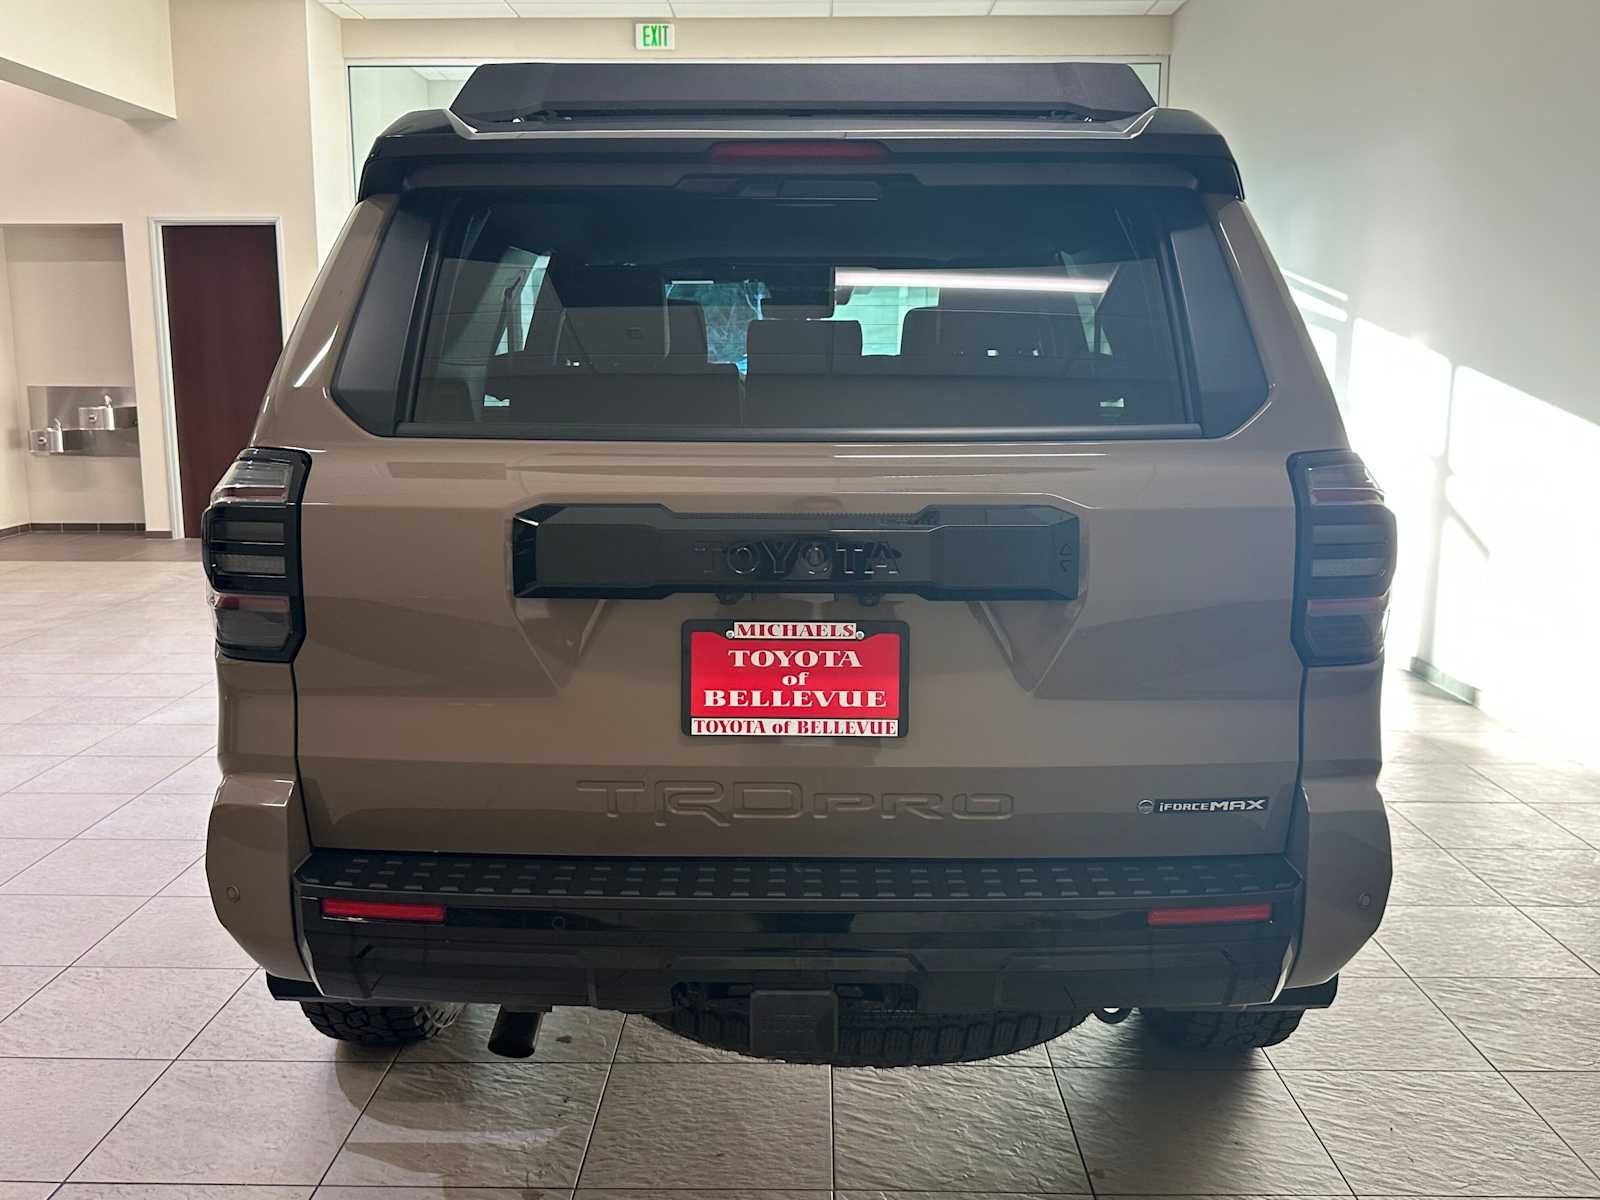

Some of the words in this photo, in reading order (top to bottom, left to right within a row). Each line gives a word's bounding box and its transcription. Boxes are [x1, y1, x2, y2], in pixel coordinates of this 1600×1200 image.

[643, 25, 669, 47] EXIT
[693, 541, 902, 576] TOYOTA
[737, 623, 855, 638] MICHAELS
[728, 650, 863, 668] TOYOTA
[781, 672, 810, 686] of
[703, 690, 887, 708] BELLEVUE
[694, 719, 766, 734] TOYOTA
[772, 719, 792, 734] of
[797, 720, 896, 735] BELLEVUE
[576, 779, 803, 826] TRD
[812, 792, 1015, 820] PRO
